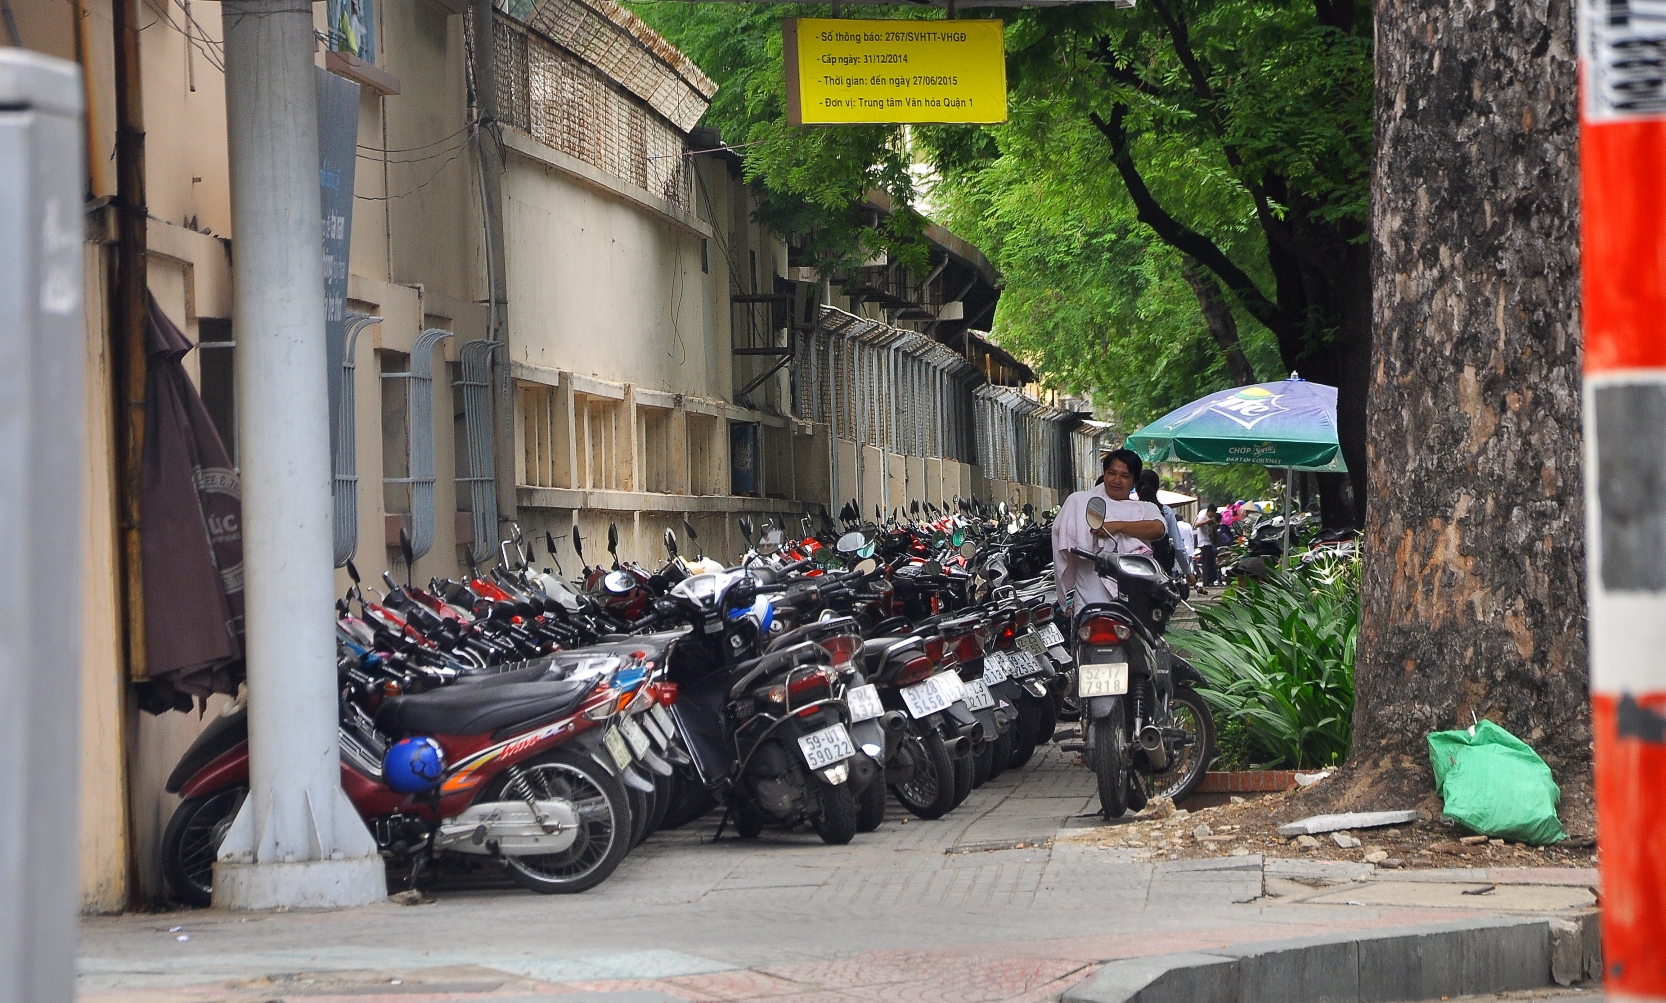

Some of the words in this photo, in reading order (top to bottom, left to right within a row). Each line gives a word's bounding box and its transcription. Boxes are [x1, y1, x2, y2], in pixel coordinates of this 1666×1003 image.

[821, 30, 834, 41] Số
[835, 32, 861, 44] thông
[863, 32, 882, 42] báo:
[885, 32, 967, 43] 2767/SVHTT-VHGĐ
[821, 53, 837, 66] Cấp
[838, 54, 860, 66] ngày:
[863, 54, 908, 64] 31/12/2014
[823, 75, 843, 86] Thời
[845, 75, 868, 88] gian:
[870, 74, 887, 86] đến
[889, 75, 910, 88] ngày
[912, 75, 958, 86] 27/06/2015
[825, 97, 843, 107] Đơn
[858, 97, 884, 110] Trung
[886, 97, 903, 107] tâm
[905, 97, 922, 107] Văn
[924, 97, 941, 107] hóa
[943, 97, 966, 109] Quận
[969, 98, 973, 107] 1
[1086, 680, 1121, 694] 7918
[914, 694, 945, 714] 5458
[805, 729, 840, 750] 59-U1
[807, 741, 852, 766] 590.22
